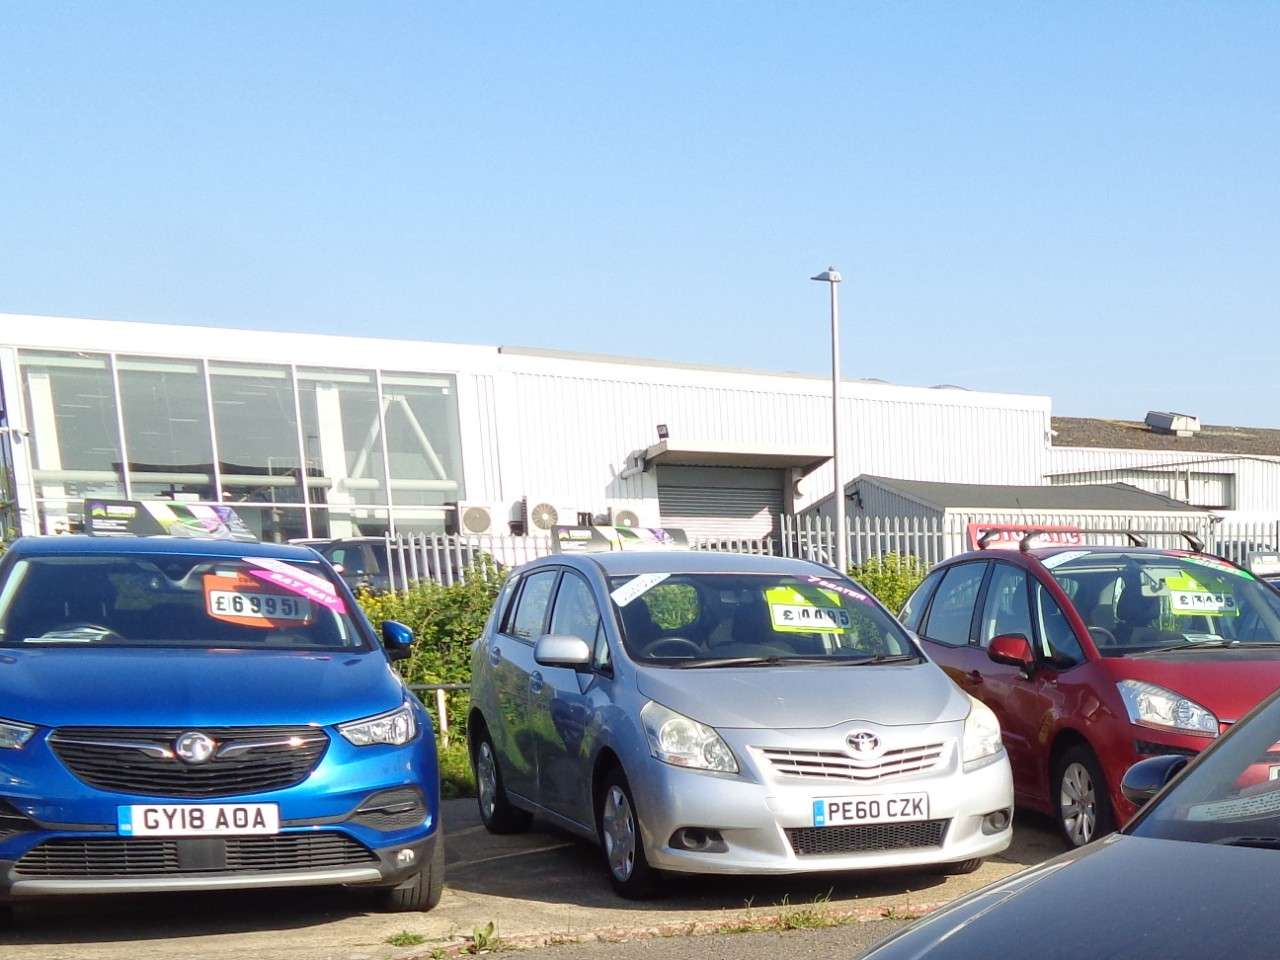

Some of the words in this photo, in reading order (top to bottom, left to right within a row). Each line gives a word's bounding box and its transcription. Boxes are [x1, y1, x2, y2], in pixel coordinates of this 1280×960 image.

[976, 529, 1080, 544] TOATIC
[143, 807, 205, 830] GY18
[828, 801, 881, 821] PE60
[886, 797, 924, 817] CZK
